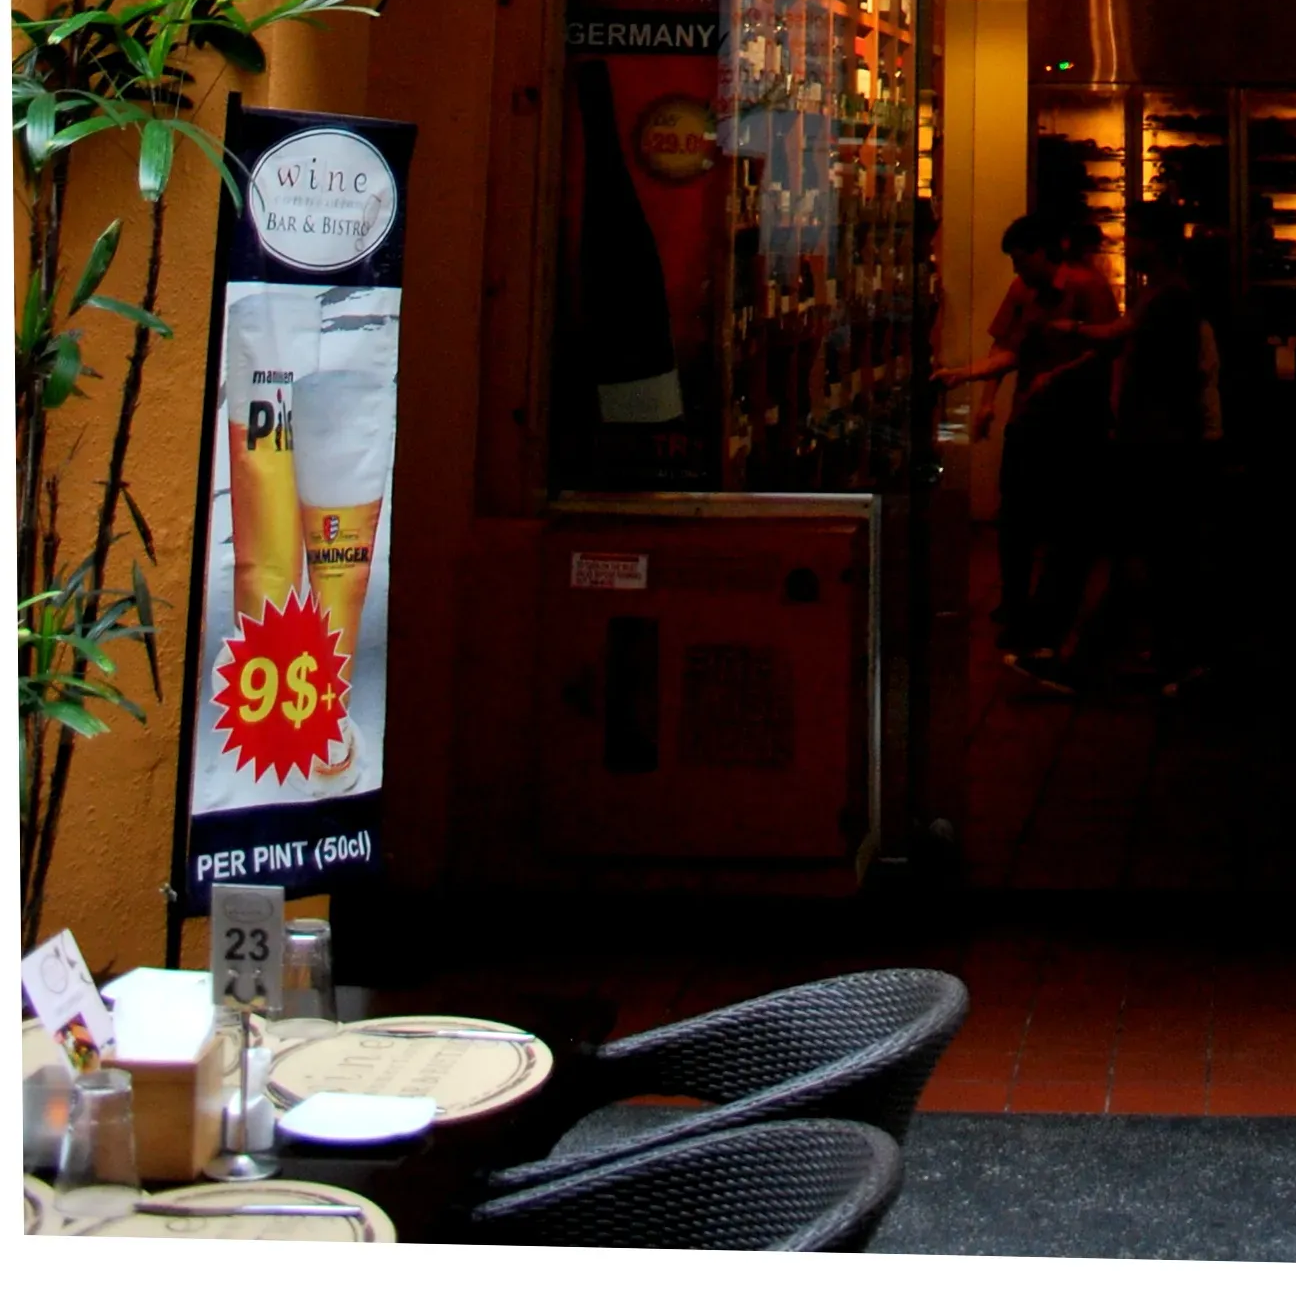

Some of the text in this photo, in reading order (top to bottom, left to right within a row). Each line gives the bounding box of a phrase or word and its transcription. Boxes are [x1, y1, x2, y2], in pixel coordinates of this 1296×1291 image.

[566, 22, 716, 48] GERMANY
[277, 157, 368, 194] wine
[302, 214, 316, 234] &
[196, 829, 372, 882] PER PINT (50cl)
[224, 927, 270, 962] 23
